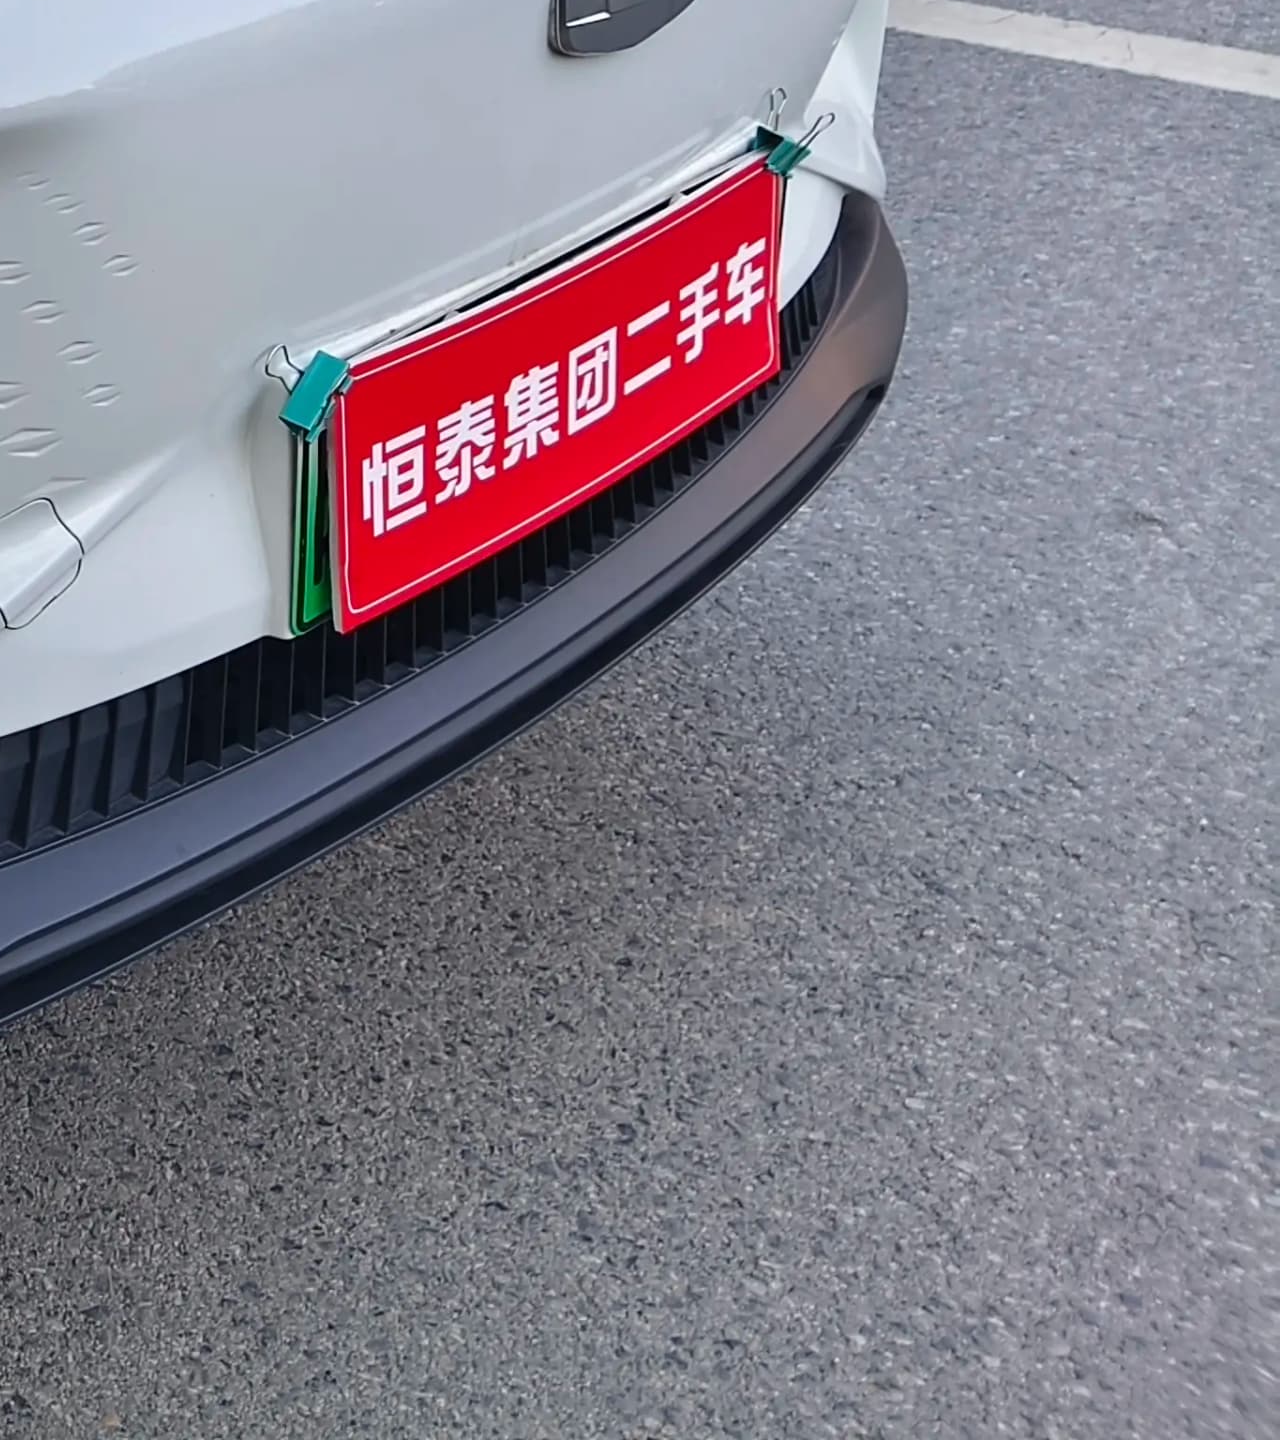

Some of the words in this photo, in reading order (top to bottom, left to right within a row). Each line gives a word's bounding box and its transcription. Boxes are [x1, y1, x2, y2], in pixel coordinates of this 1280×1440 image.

[361, 236, 767, 538] 恒泰集团二手车
